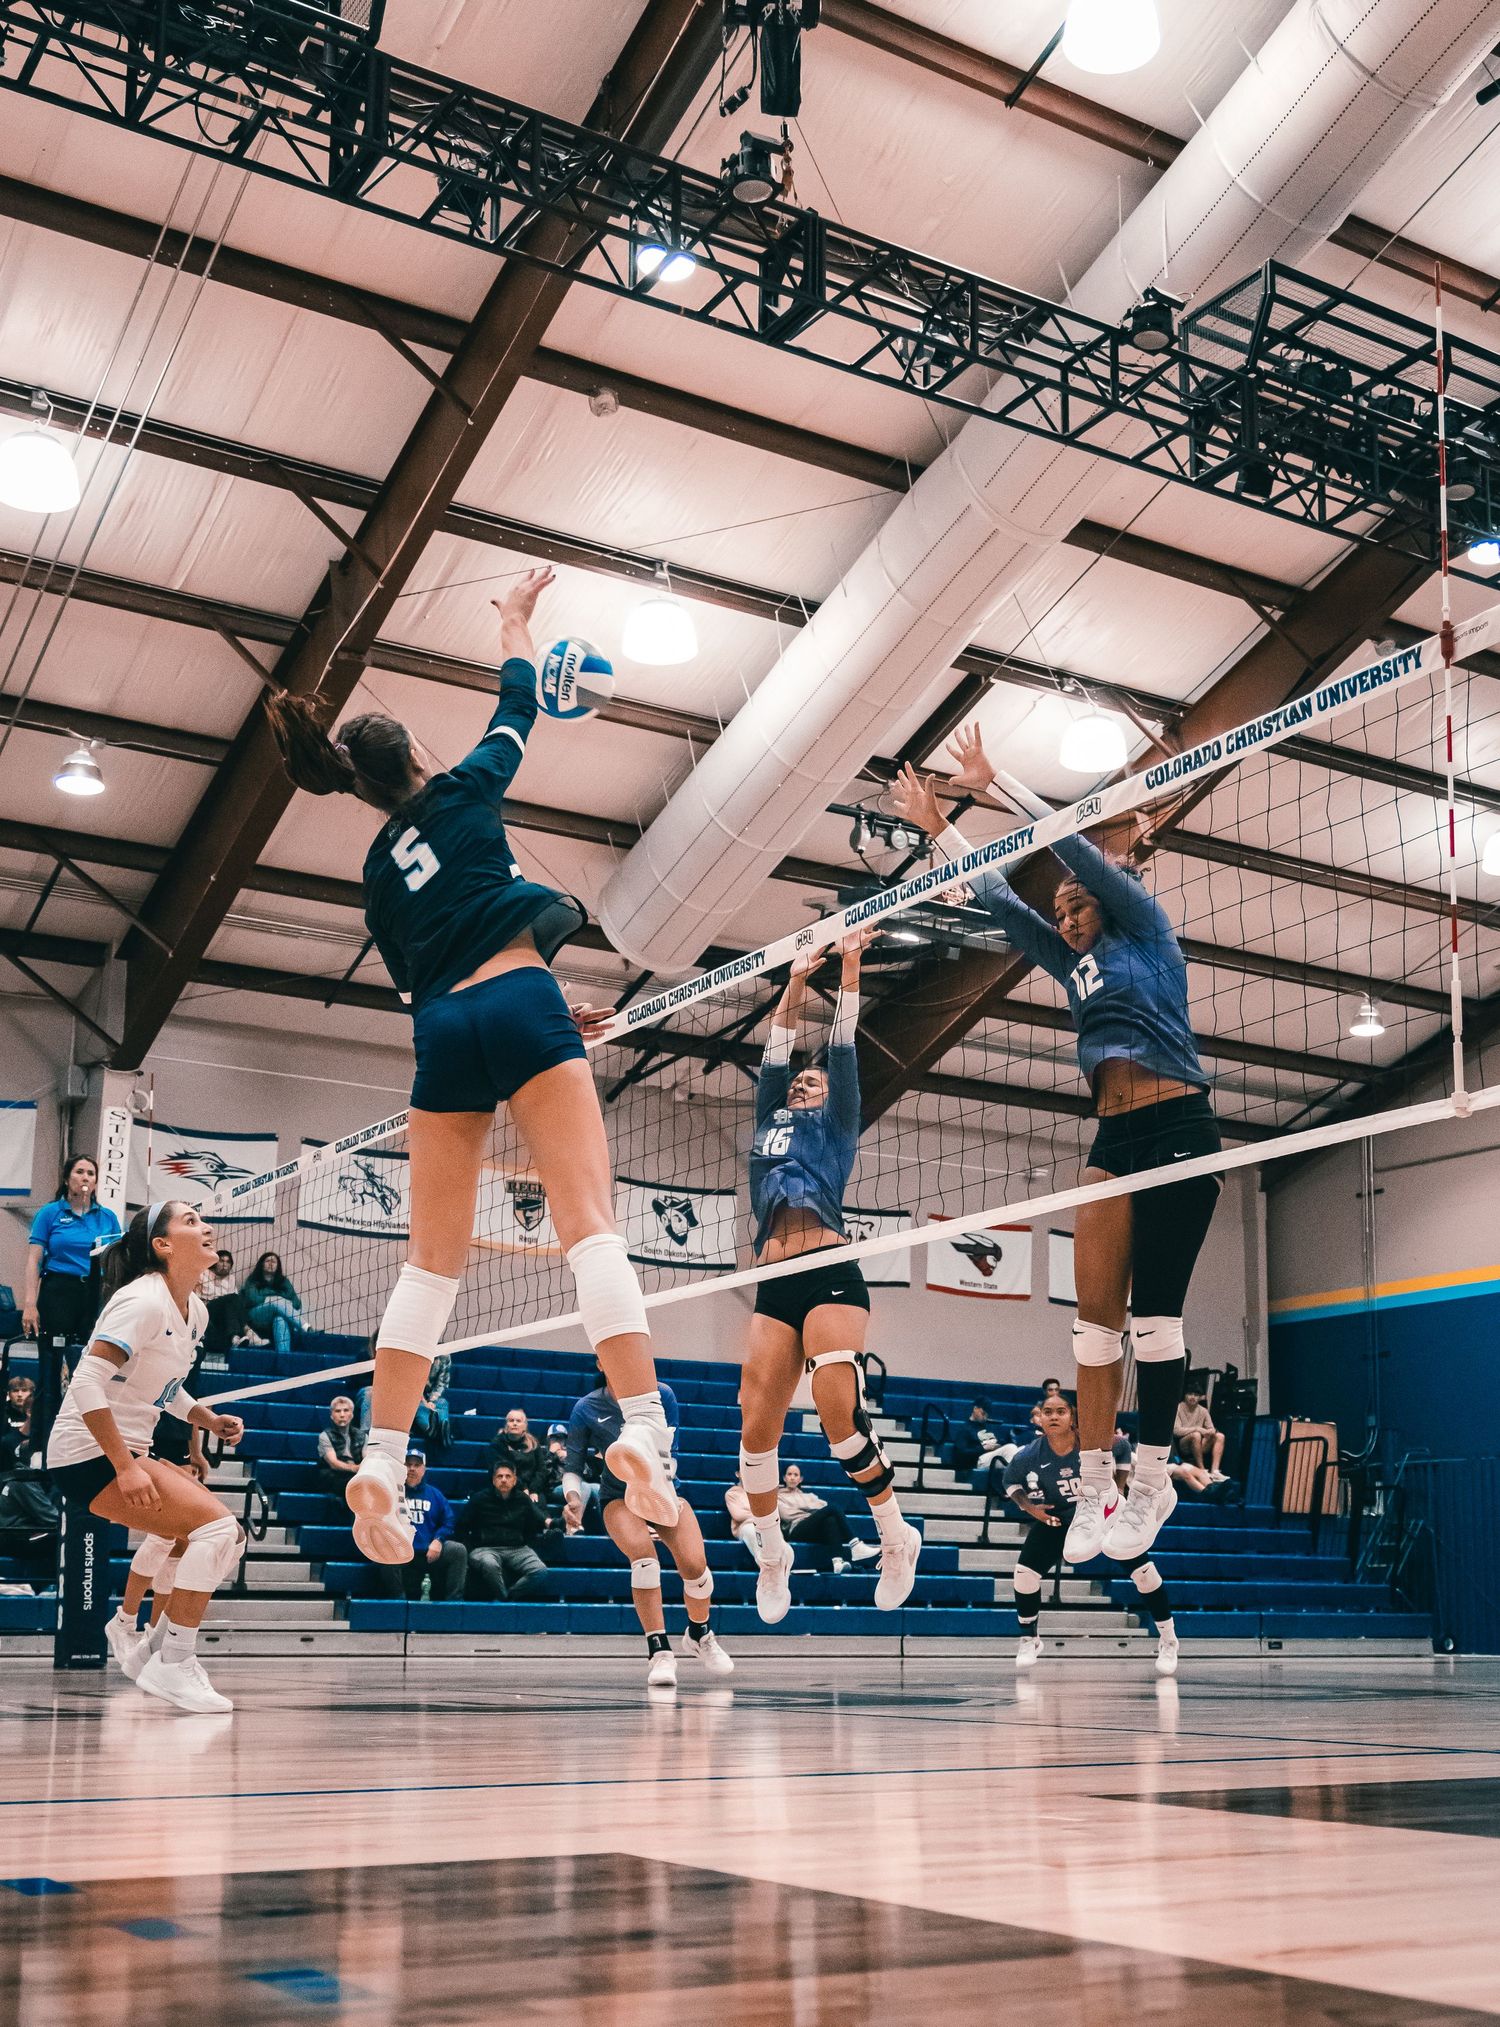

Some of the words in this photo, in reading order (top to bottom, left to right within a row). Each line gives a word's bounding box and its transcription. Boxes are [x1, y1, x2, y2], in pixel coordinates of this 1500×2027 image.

[544, 653, 563, 696] NCAA
[560, 652, 577, 701] molten
[1145, 741, 1222, 790] COLORADO
[1226, 698, 1313, 755] CHRISTIAN
[1317, 646, 1422, 713] UNIVERSITY
[1076, 797, 1102, 823] CCU
[390, 826, 441, 891] 5
[844, 888, 898, 928] COLORADO
[900, 859, 959, 905] CHRISTIAN
[961, 826, 1035, 873] UNIVERSITY
[795, 929, 814, 951] CCU
[627, 997, 667, 1025] COLORADO
[668, 974, 713, 1006] CHRISTIAN
[714, 950, 767, 986] UNIVERSITY
[1070, 954, 1104, 1001] 12
[104, 1110, 127, 1198] STUDENT
[762, 1125, 795, 1156] 16
[328, 1213, 344, 1222] New
[345, 1216, 372, 1227] Mexico
[643, 1245, 662, 1256] South
[664, 1248, 686, 1258] Dakota
[83, 1532, 94, 1568] sports
[81, 1569, 93, 1611] imports
